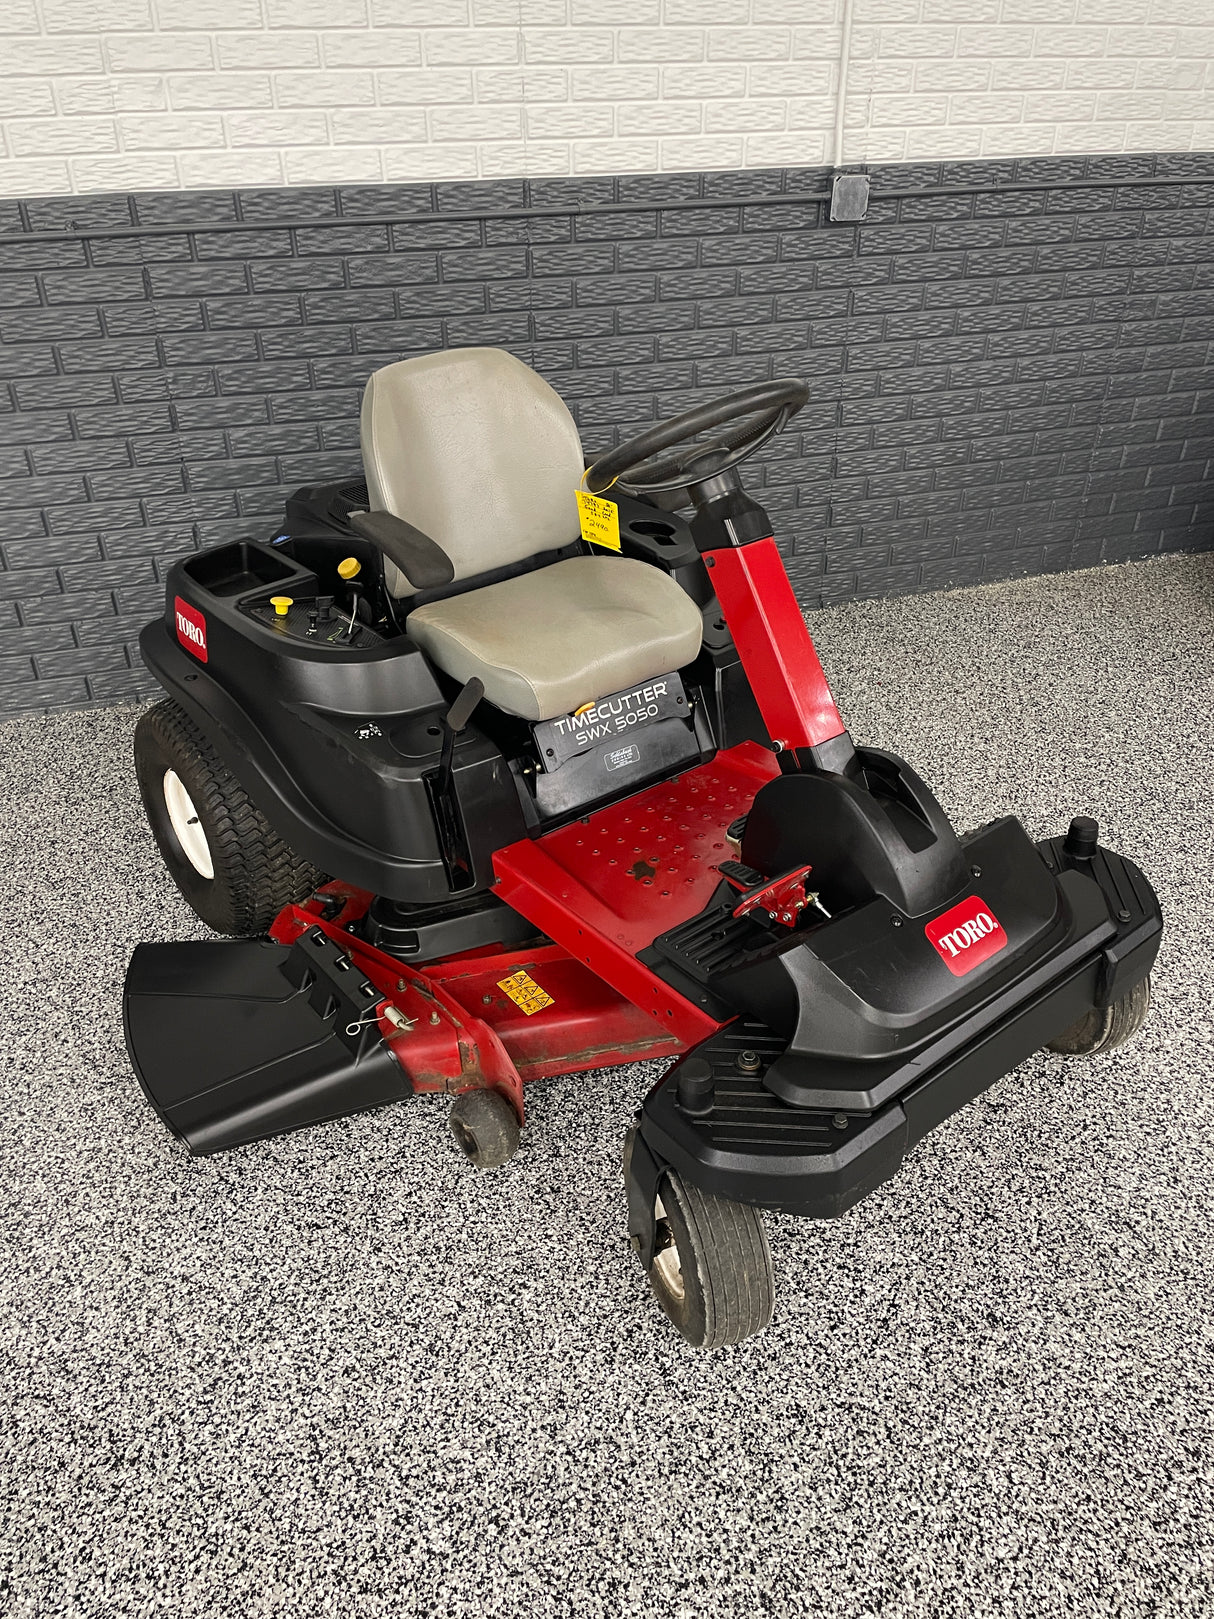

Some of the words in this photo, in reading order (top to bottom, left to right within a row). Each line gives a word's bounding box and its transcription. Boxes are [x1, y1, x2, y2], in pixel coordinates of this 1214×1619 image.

[554, 681, 667, 735] TIMECUTTER
[576, 722, 612, 746] SWX
[615, 704, 659, 730] 5050
